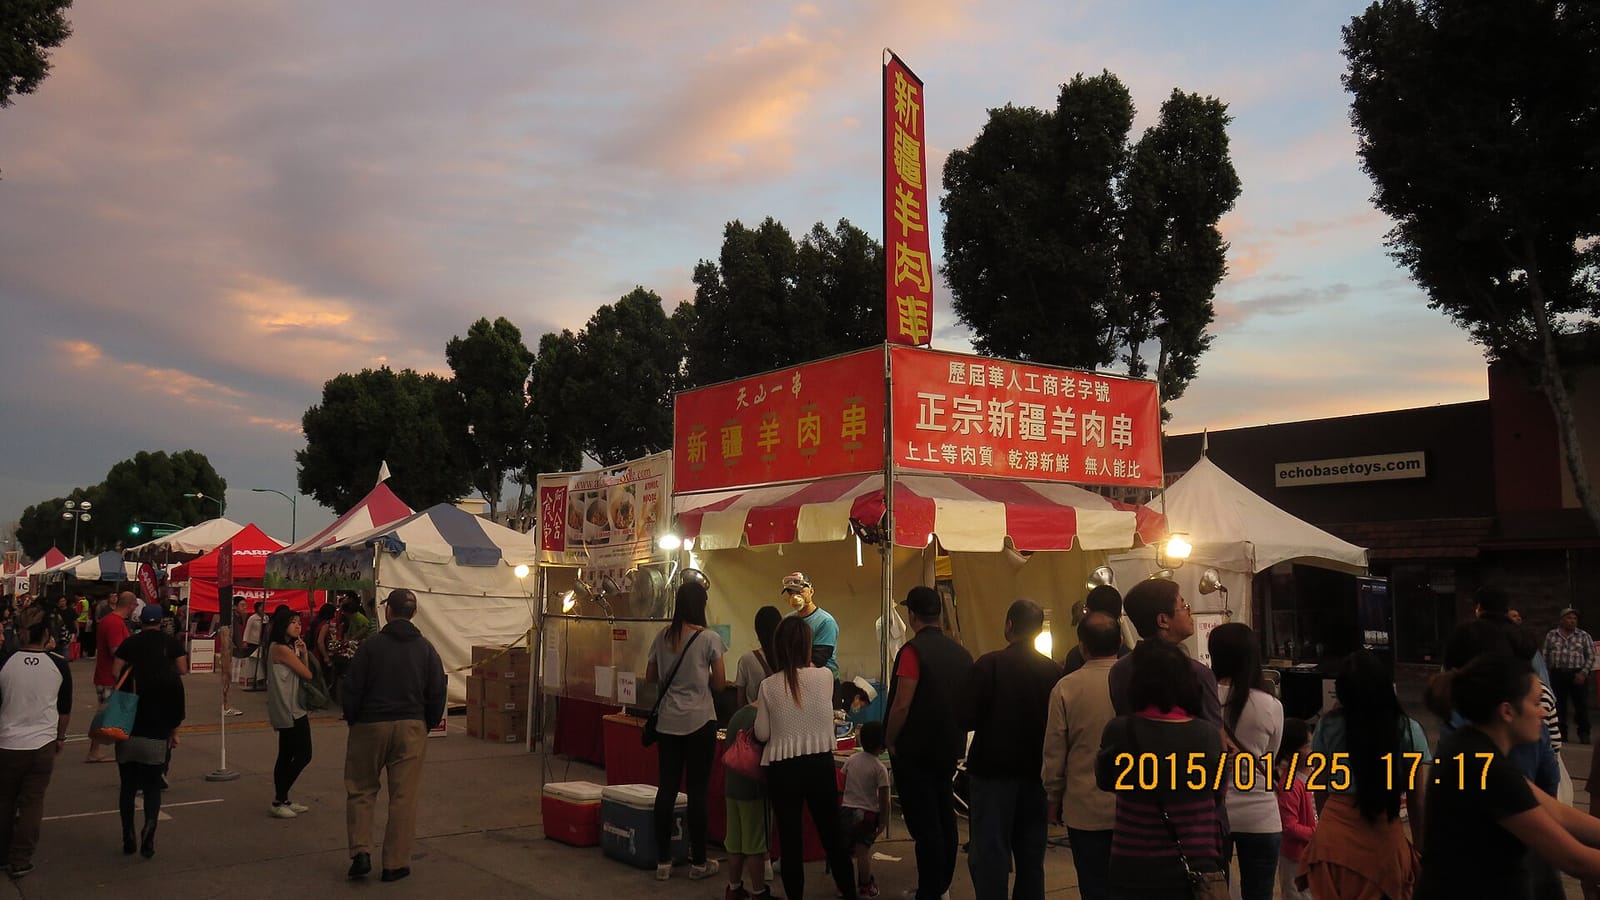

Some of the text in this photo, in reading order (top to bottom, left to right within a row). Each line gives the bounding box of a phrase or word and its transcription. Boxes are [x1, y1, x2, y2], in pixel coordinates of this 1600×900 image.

[894, 71, 930, 345] 新疆羊肉串
[736, 371, 803, 411] 天山一串
[948, 361, 1111, 404] 歷屆華人工商老字號
[687, 404, 866, 464] 新疆羊肉串
[915, 391, 1133, 450] 正宗新疆羊肉串
[905, 441, 993, 467] 上上等肉質
[1008, 449, 1070, 473] 乾淨新鮮
[1084, 456, 1141, 479] 無人能比
[1279, 459, 1421, 479] echobasetoys.com
